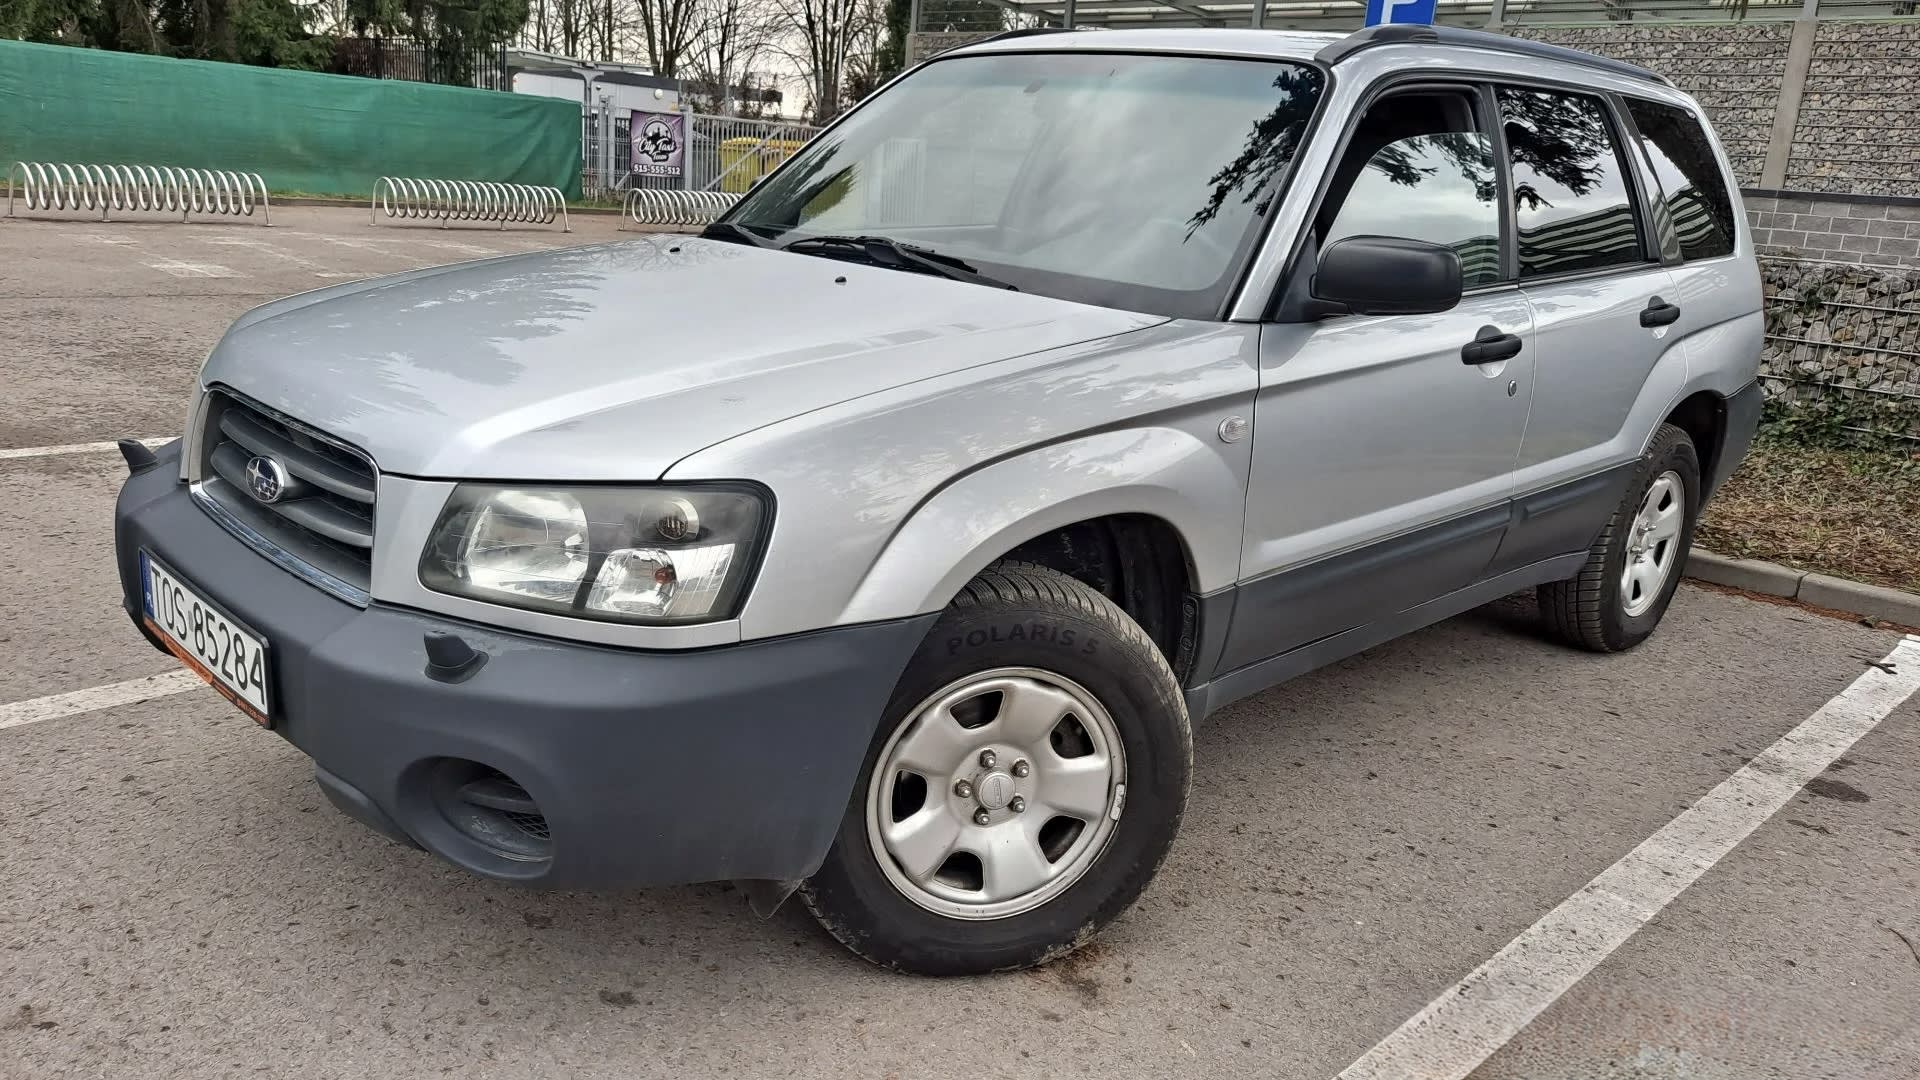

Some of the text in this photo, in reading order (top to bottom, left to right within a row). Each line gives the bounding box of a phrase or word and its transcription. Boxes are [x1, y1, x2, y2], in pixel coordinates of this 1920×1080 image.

[639, 138, 675, 154] City Taxi
[633, 164, 681, 175] 515-555-512
[151, 566, 187, 640] TOS
[193, 602, 265, 705] 85284
